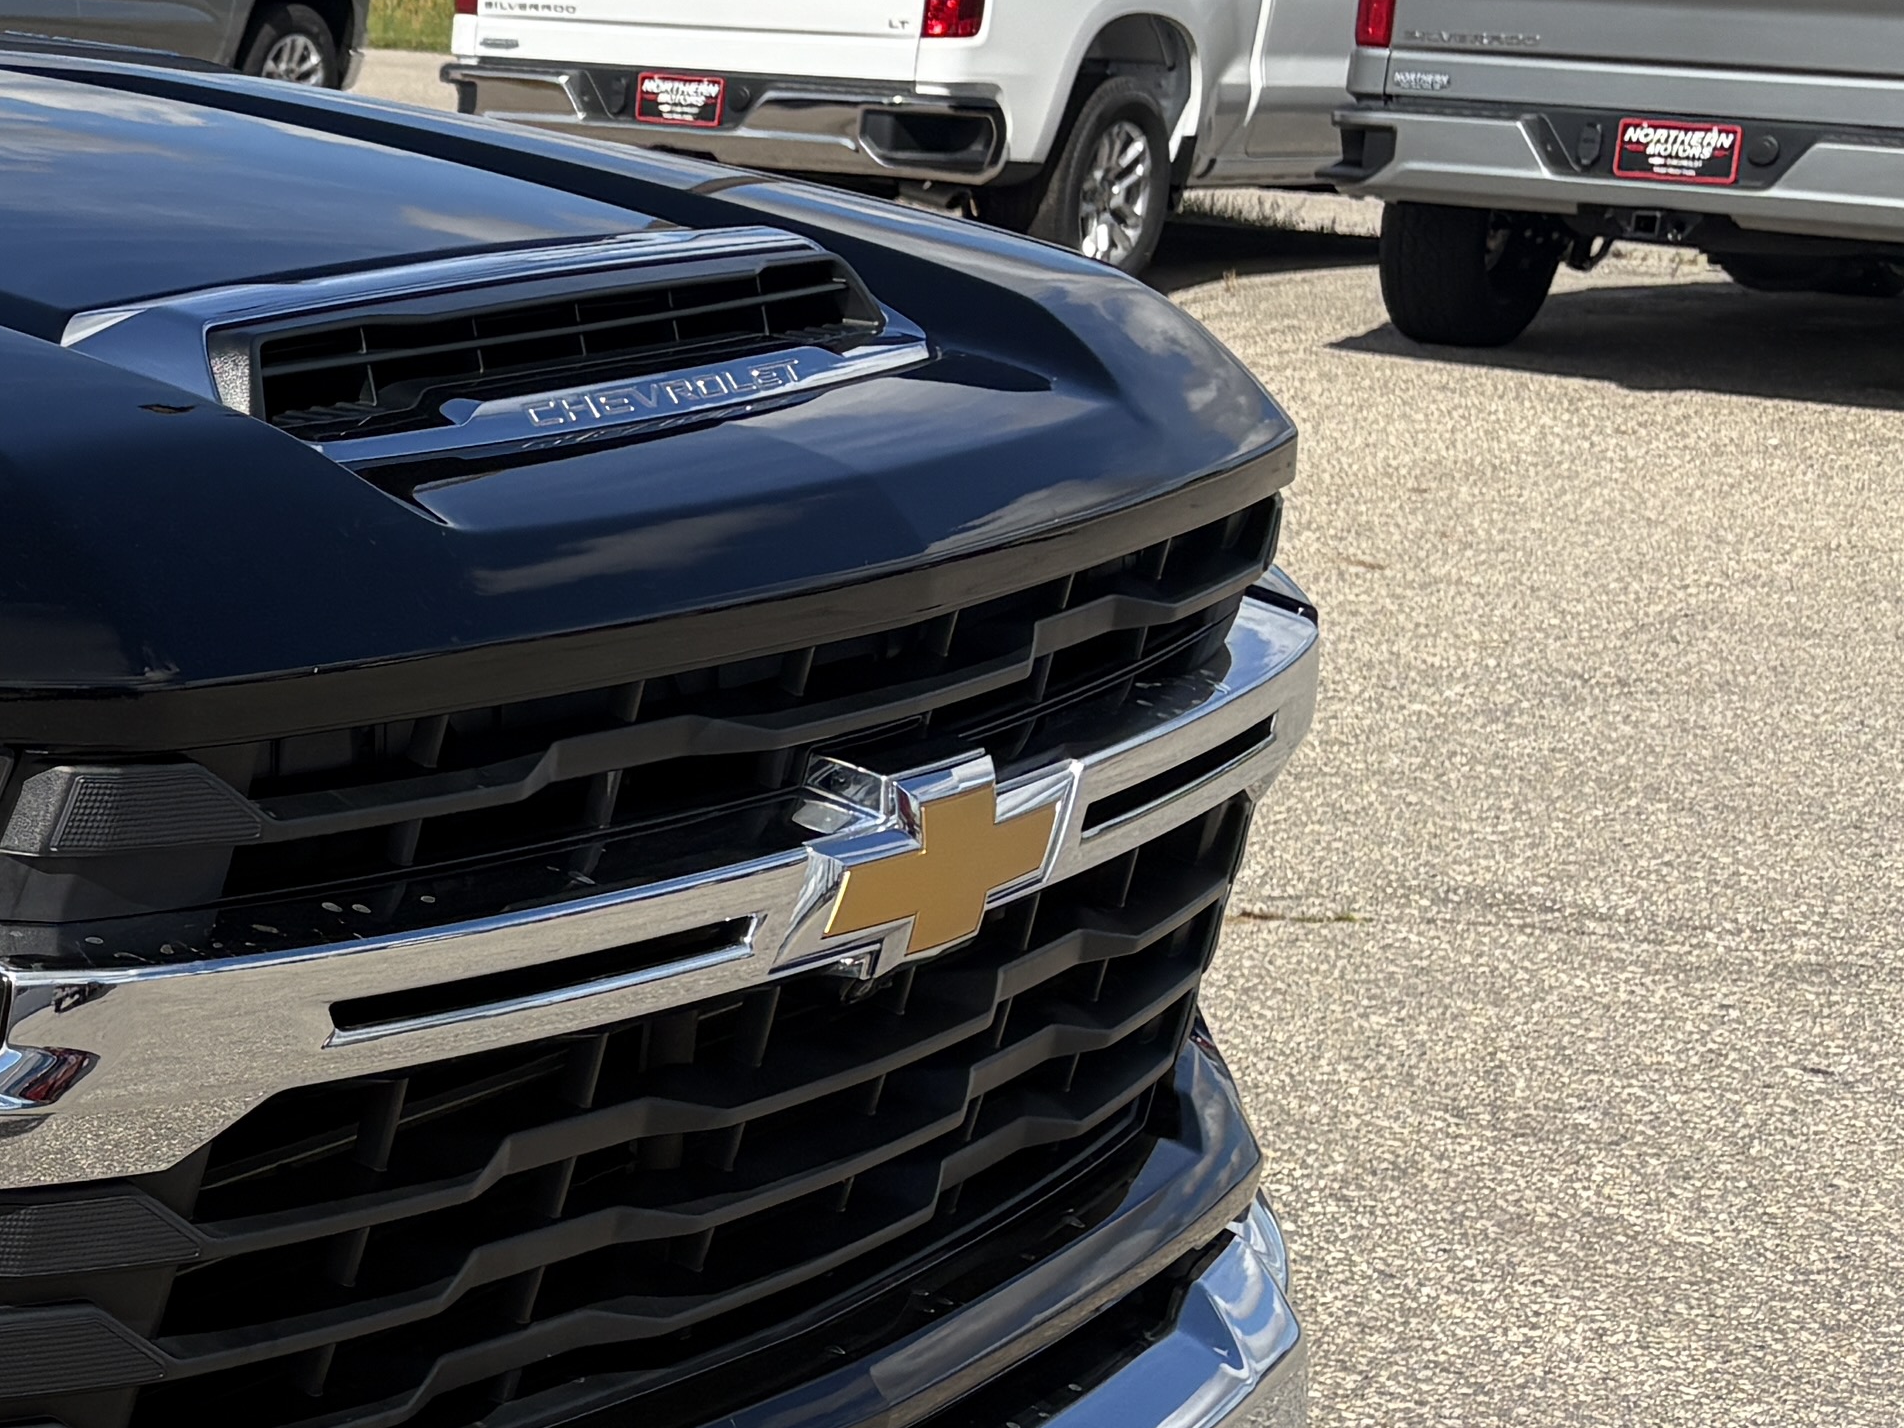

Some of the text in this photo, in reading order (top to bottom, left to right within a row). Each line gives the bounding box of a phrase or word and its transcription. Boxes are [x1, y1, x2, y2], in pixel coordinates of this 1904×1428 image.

[888, 19, 910, 30] LT
[1623, 125, 1735, 149] NORTHERN
[522, 358, 799, 427] CHEVROLET
